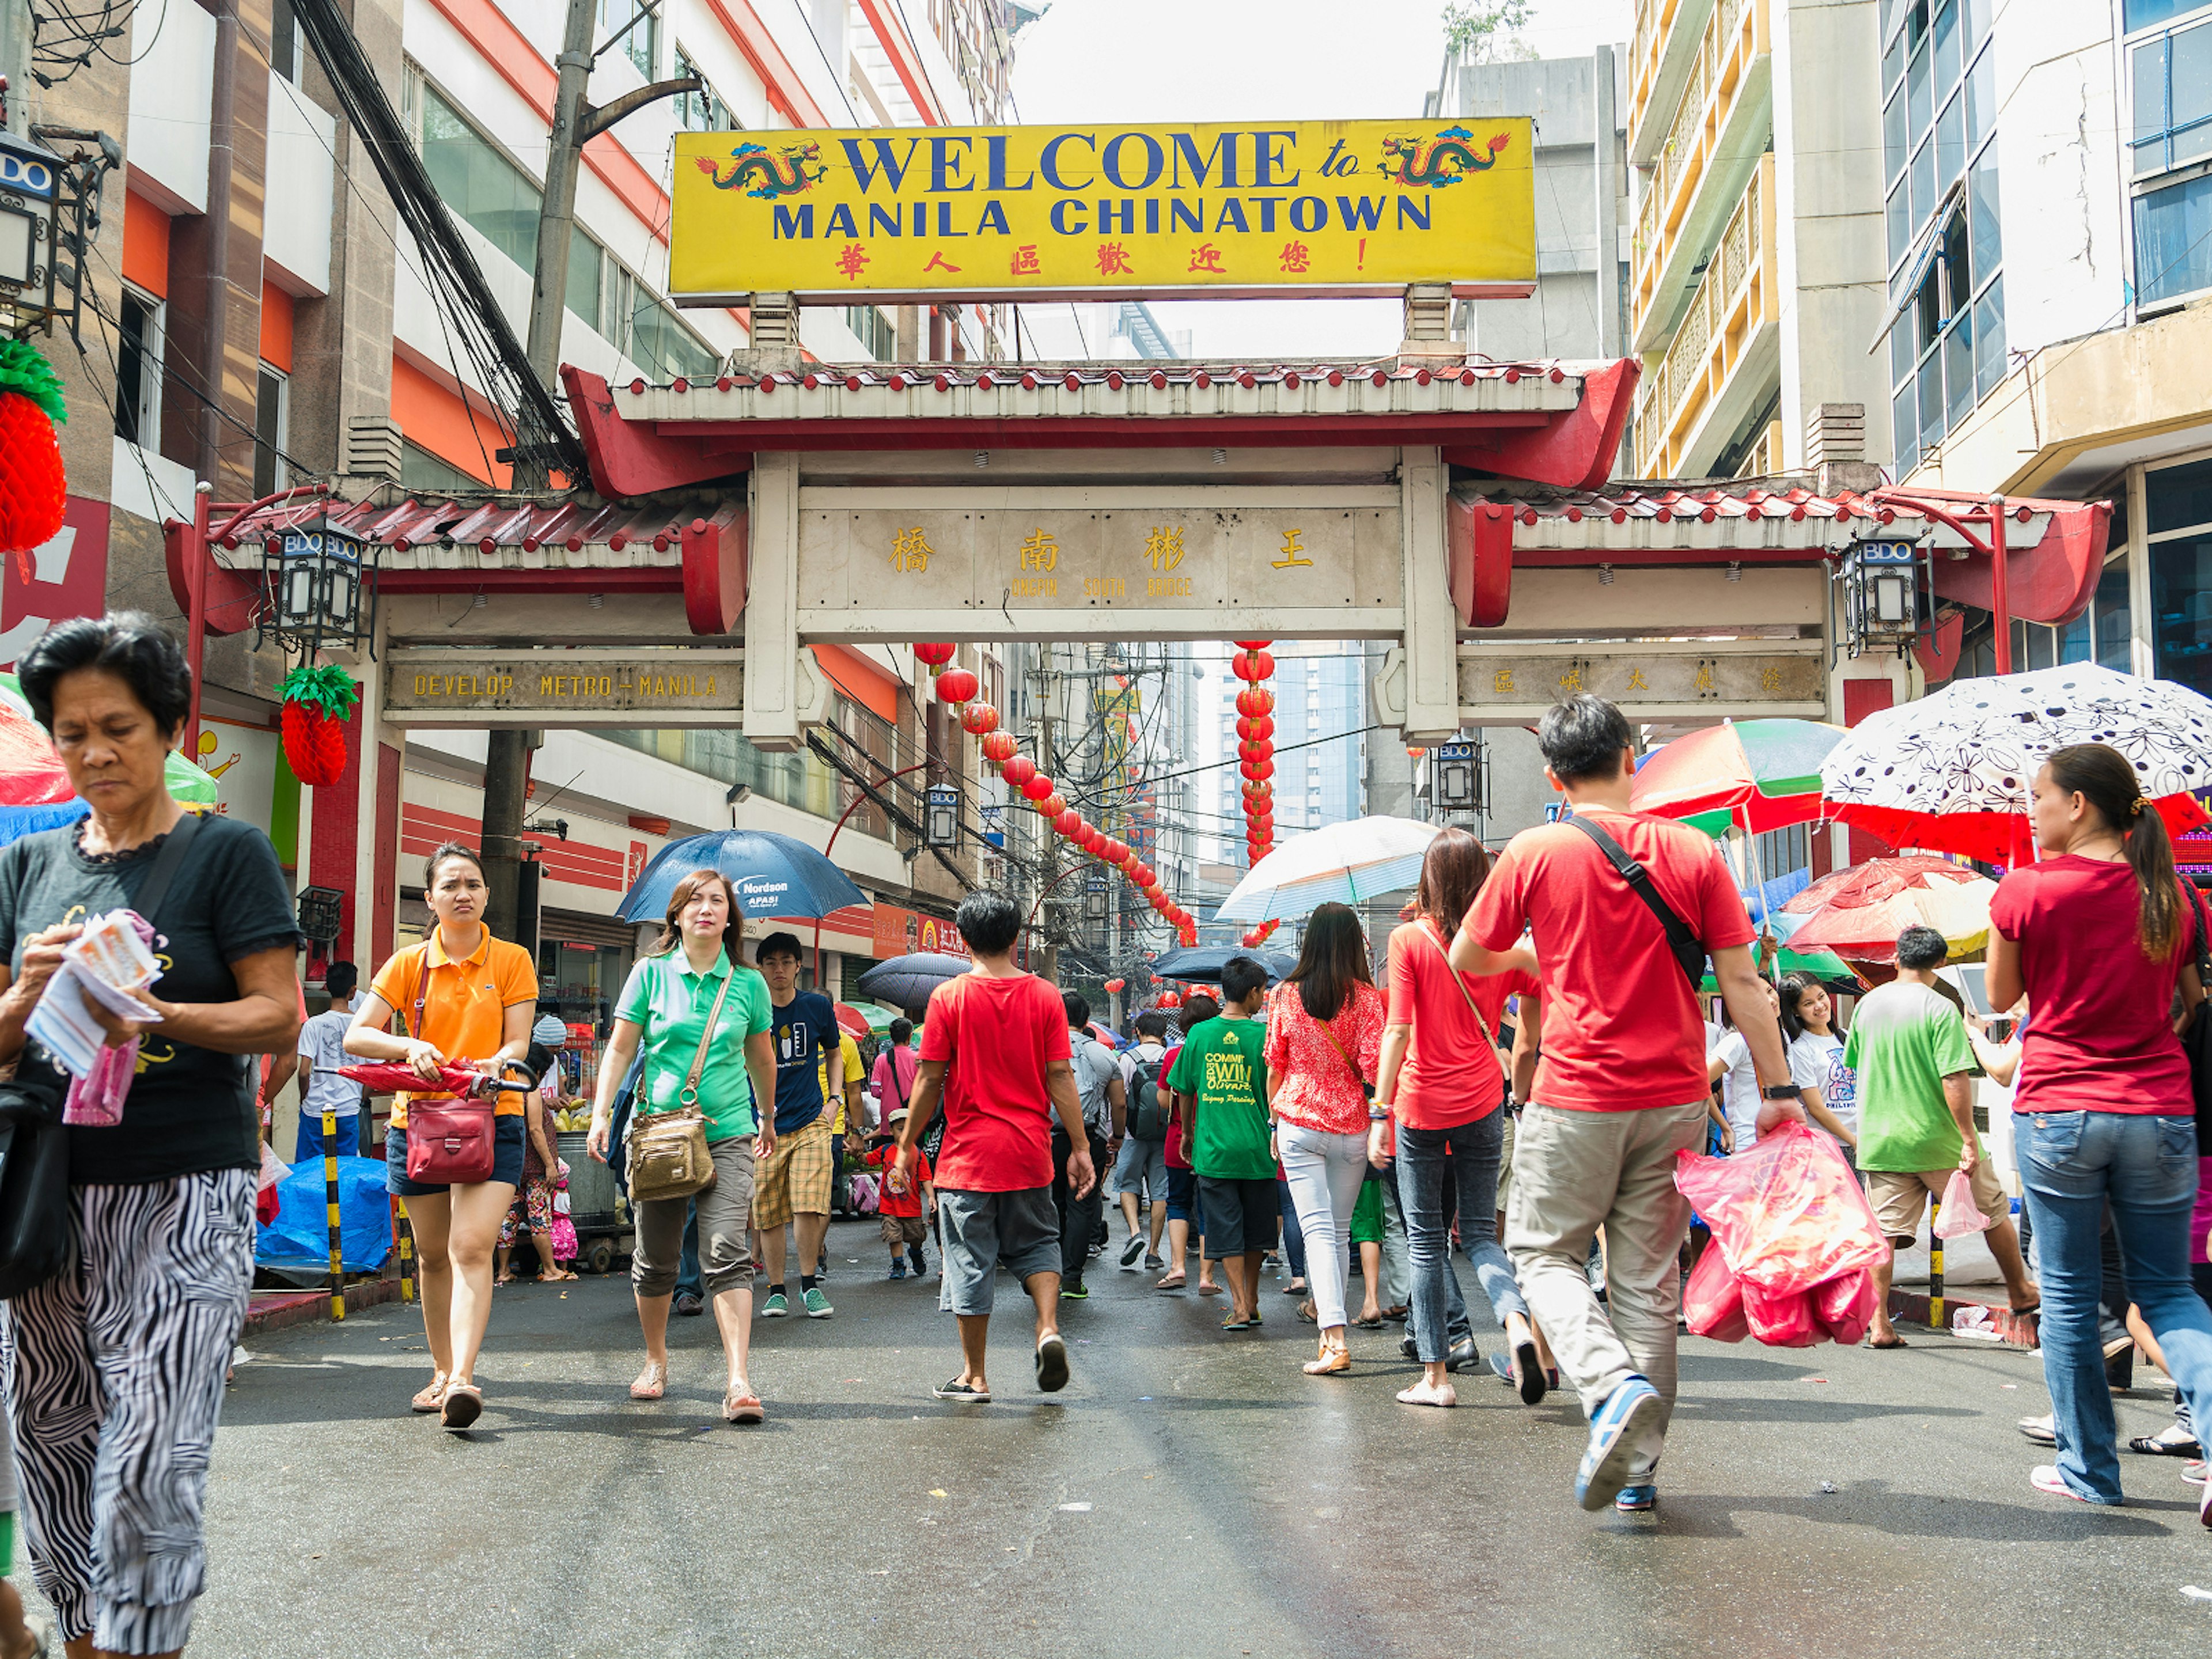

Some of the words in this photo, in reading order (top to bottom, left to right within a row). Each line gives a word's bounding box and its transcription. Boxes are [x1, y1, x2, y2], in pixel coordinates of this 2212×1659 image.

[838, 131, 1301, 194] WELCOME
[1316, 138, 1359, 178] to
[774, 200, 1011, 240] MANILA
[1050, 195, 1432, 235] CHINATOWN
[285, 533, 323, 552] BDO
[327, 534, 358, 559] BDO
[1863, 542, 1912, 560] BDO
[1012, 578, 1058, 597] ONGPIN
[1084, 577, 1125, 597] SOUTH
[1148, 577, 1192, 597] BRIDGE
[415, 675, 513, 696] DEVELOP
[1440, 744, 1471, 757] BDO
[930, 792, 957, 804] BDO
[743, 882, 787, 894] Nordson
[1205, 1052, 1245, 1064] COMMIT
